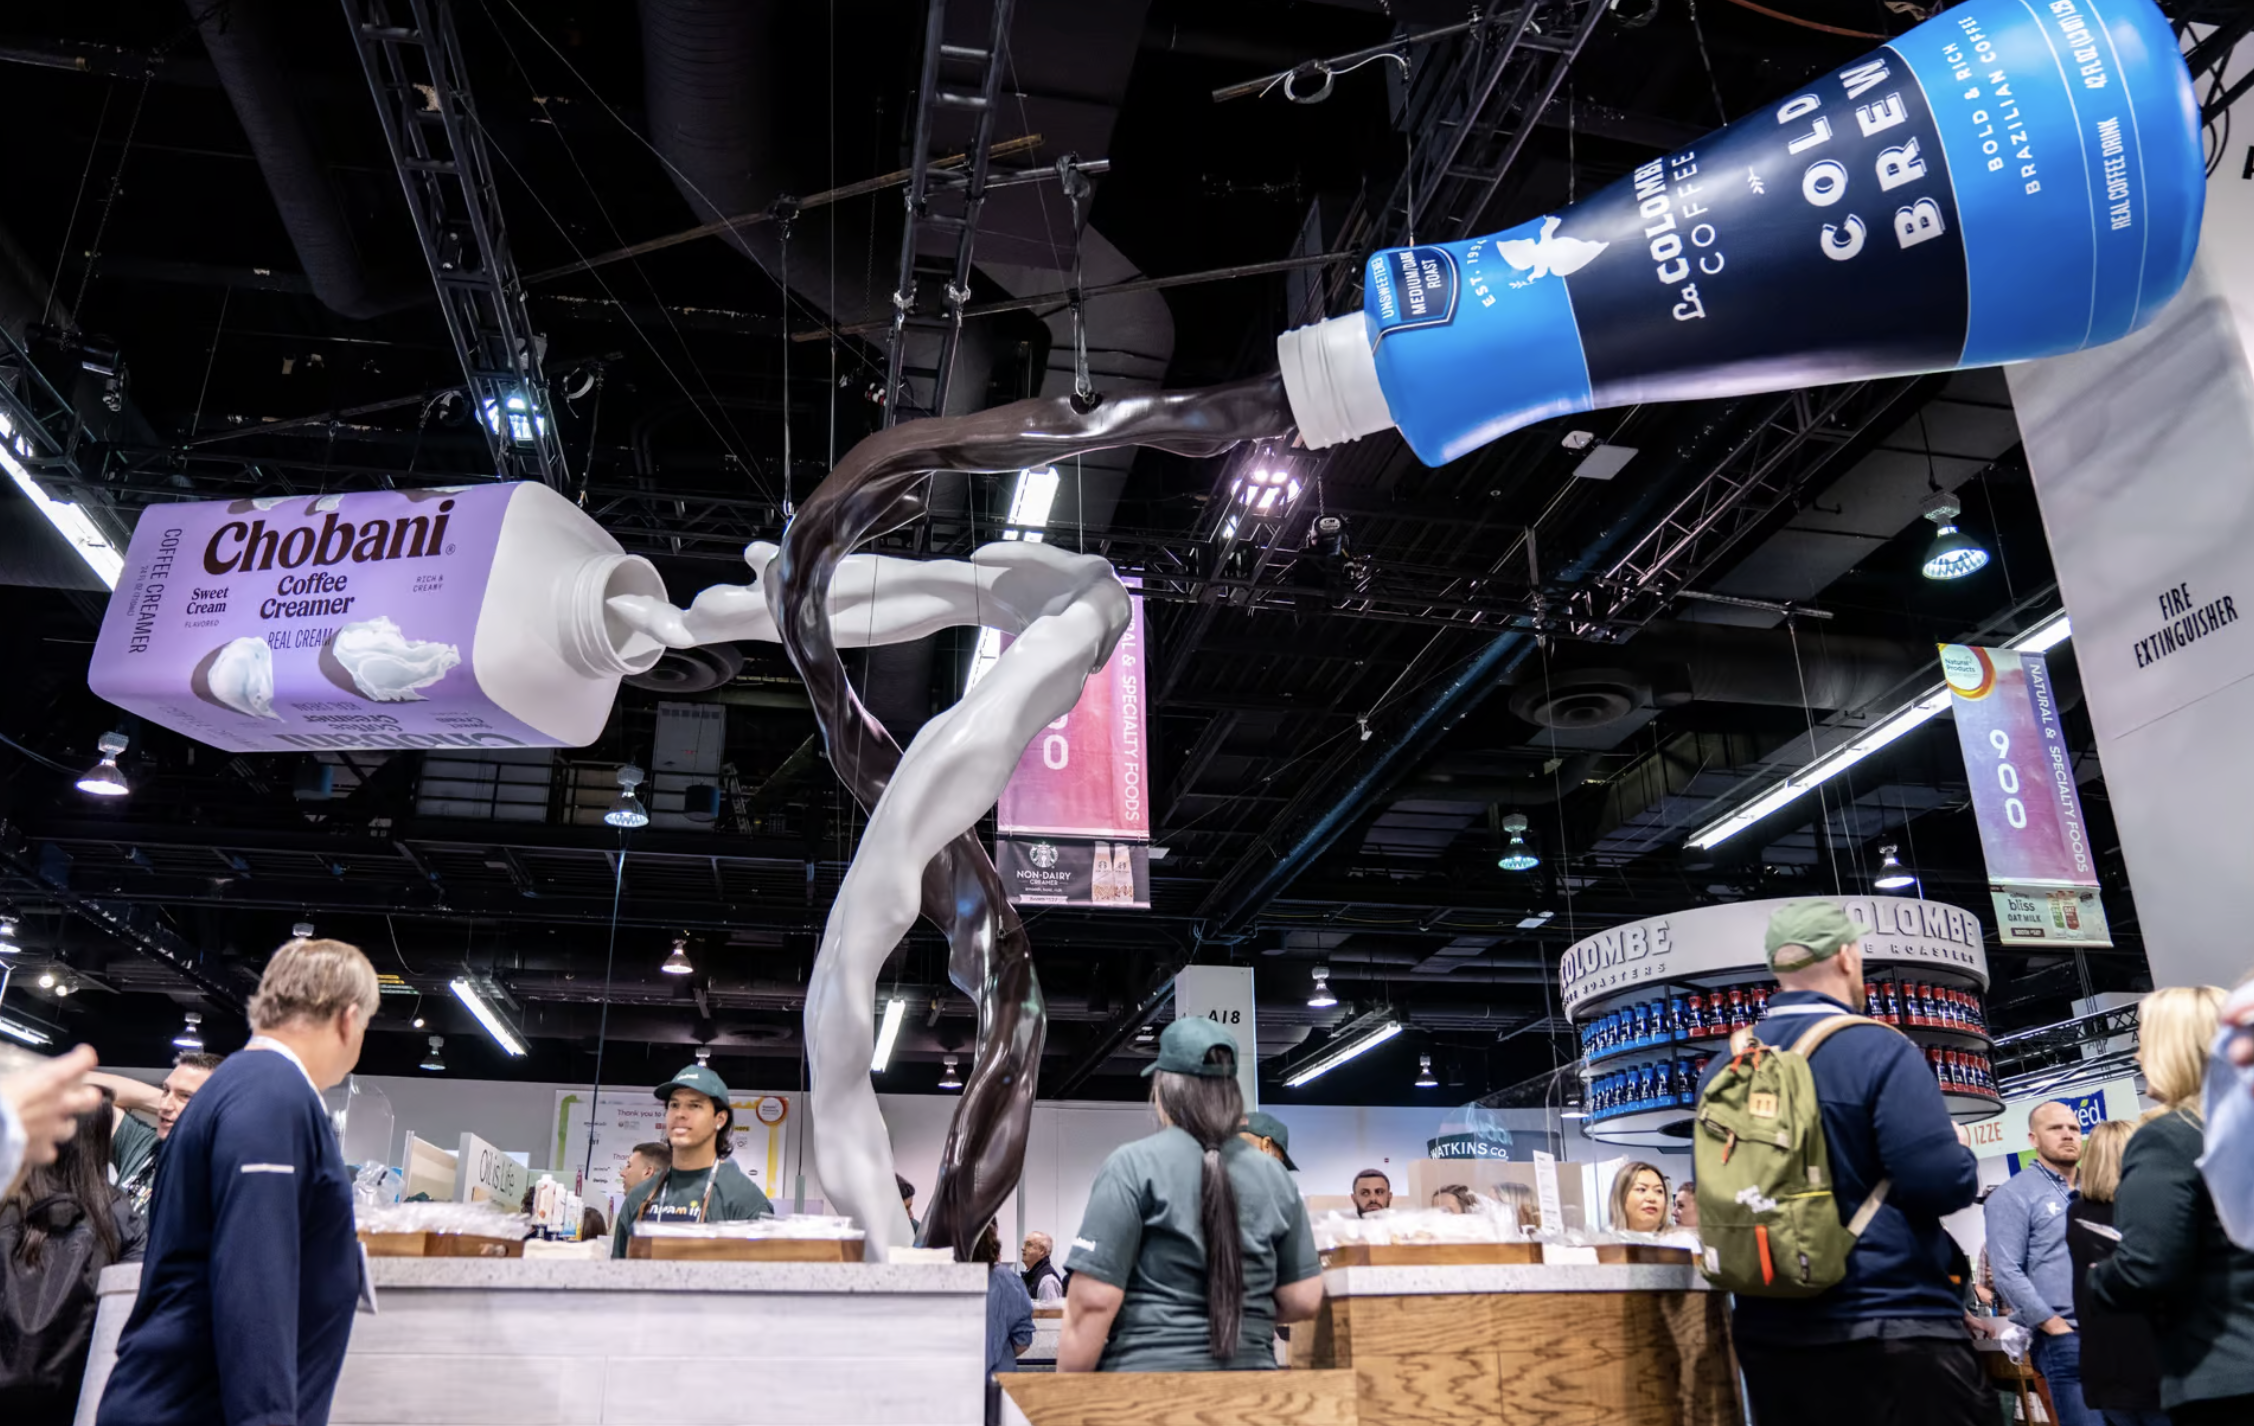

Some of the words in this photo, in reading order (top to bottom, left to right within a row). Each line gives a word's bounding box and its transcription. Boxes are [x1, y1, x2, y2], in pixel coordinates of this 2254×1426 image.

[1942, 42, 1972, 82] RICH
[1958, 16, 1997, 63] COFFEE
[1964, 86, 1981, 100] &
[1839, 58, 1946, 249] BREW
[1972, 110, 2004, 172] BOLD
[1988, 69, 2041, 195] BRAZILIAN
[2097, 116, 2123, 157] DRINK
[1777, 93, 1867, 261] COLD
[2103, 155, 2130, 201] COFFEE
[1671, 151, 1725, 275] COFFEE
[2110, 199, 2132, 231] REAL
[1399, 250, 1427, 315] MEDIUM/DARK
[1421, 259, 1442, 289] ROAST
[149, 528, 183, 580] COFFEE
[203, 499, 454, 575] Chobani
[191, 586, 229, 600] Sweet
[277, 572, 348, 596] Coffee
[2159, 582, 2193, 621] FIRE
[128, 583, 165, 654] CREAMER
[184, 619, 220, 628] FLAVORED
[186, 602, 227, 615] Cream
[260, 597, 355, 619] Creamer
[267, 630, 291, 650] REAL
[295, 627, 334, 649] CREAM
[2134, 595, 2239, 669] EXTINGUISHER
[1122, 654, 1136, 667] &
[2029, 663, 2053, 724] NATURAL
[1122, 675, 1139, 759] SPECIALTY
[2045, 728, 2056, 739] &
[1125, 762, 1140, 821] FOODS
[1989, 729, 2027, 829] 900
[2049, 745, 2076, 818] SPECIALTY
[2066, 819, 2089, 873] FOODS
[1016, 870, 1072, 881] NON-DAIRY
[1843, 900, 1975, 948] OLOMBE
[2008, 899, 2035, 911] bliss
[1430, 1142, 1488, 1160] WATKINS
[1490, 1147, 1509, 1160] CO.
